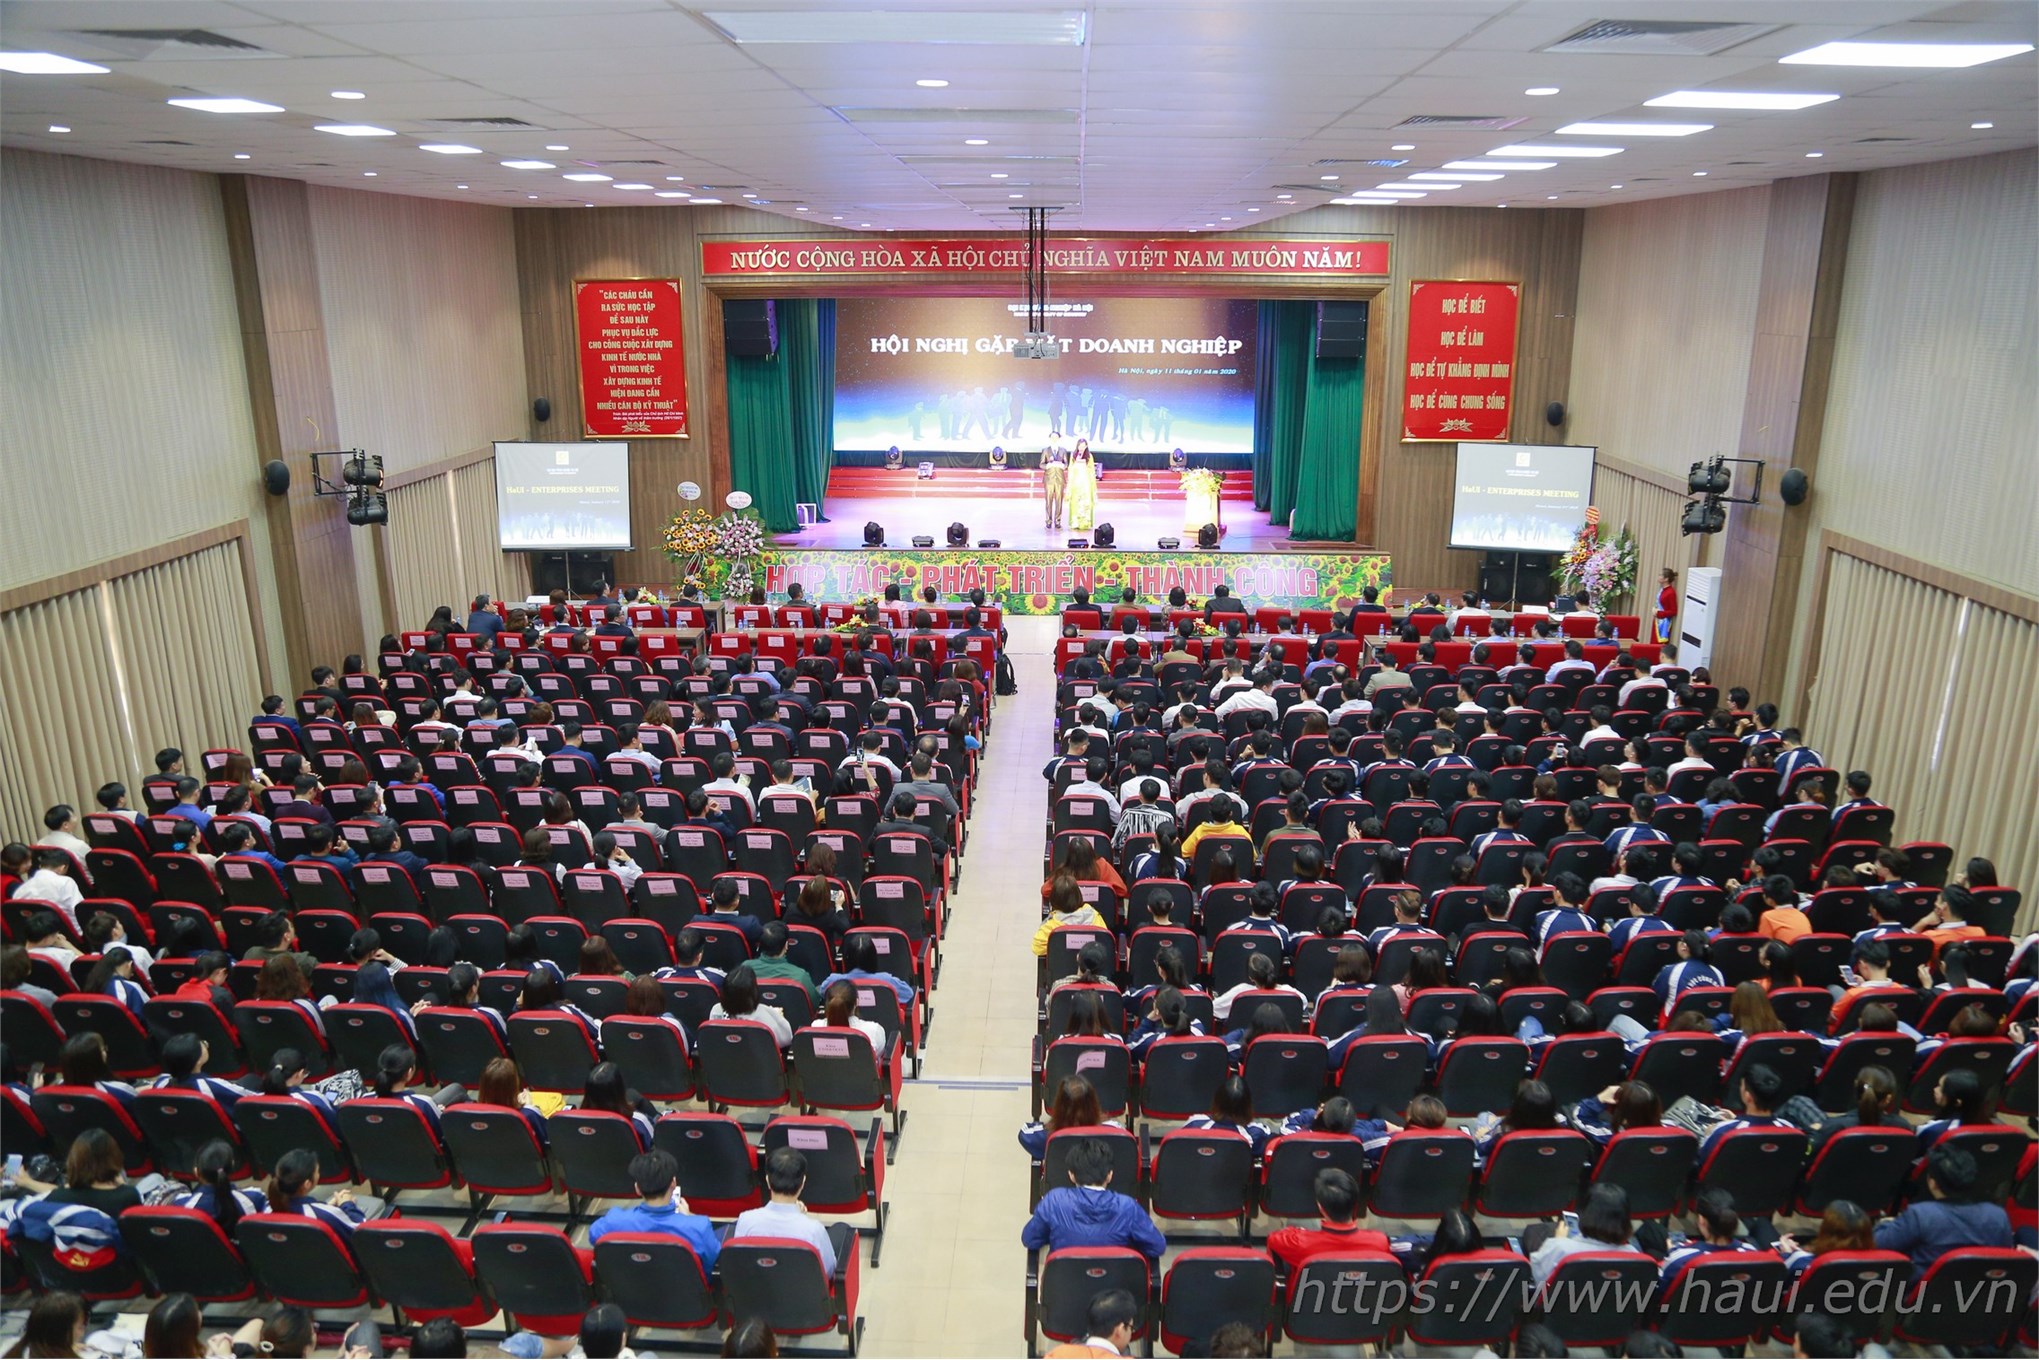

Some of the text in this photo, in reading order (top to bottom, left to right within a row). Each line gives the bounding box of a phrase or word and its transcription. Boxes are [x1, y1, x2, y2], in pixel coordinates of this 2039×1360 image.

[730, 245, 790, 269] NƯỚC
[797, 246, 855, 271] CỘNG
[861, 245, 905, 268] HÒA
[910, 246, 942, 268] XÃ
[947, 246, 986, 270] HỘI
[1115, 246, 1168, 270] VIỆT
[1173, 250, 1225, 267] NAM
[1231, 246, 1296, 268] MUÔN
[1302, 245, 1361, 269] NĂM!
[601, 304, 611, 312] RA
[628, 304, 641, 312] HỌC
[1442, 298, 1456, 316] HỌC
[1470, 294, 1486, 314] BIẾT
[620, 316, 634, 324] SAU
[602, 329, 620, 338] PHỤC
[622, 329, 630, 338] VỤ
[1440, 332, 1455, 348] HỌC
[1468, 329, 1484, 346] LÀM
[603, 339, 621, 348] CÔNG
[623, 339, 640, 350] CUỘC
[870, 334, 909, 355] HỘI
[916, 337, 969, 355] NGHỊ
[1079, 338, 1155, 354] DOANH
[1161, 335, 1243, 357] NGHIỆP
[618, 365, 639, 373] TRONG
[640, 364, 655, 374] VIỆC
[1410, 363, 1424, 379] HỌC
[1491, 361, 1510, 378] MÌNH
[1410, 394, 1424, 410] HỌC
[1460, 395, 1484, 409] CHUNG
[506, 486, 524, 494] HaUI
[531, 486, 584, 494] ENTERPRISES
[1462, 485, 1480, 493] HaUI
[1487, 487, 1541, 496] ENTERPRISES
[1542, 489, 1579, 498] MEETING
[834, 558, 890, 593] TÁC
[921, 558, 998, 594] PHÁT
[1007, 554, 1095, 594] TRIỂN
[1124, 560, 1225, 595] THÀNH
[1234, 562, 1318, 597] CÔNG
